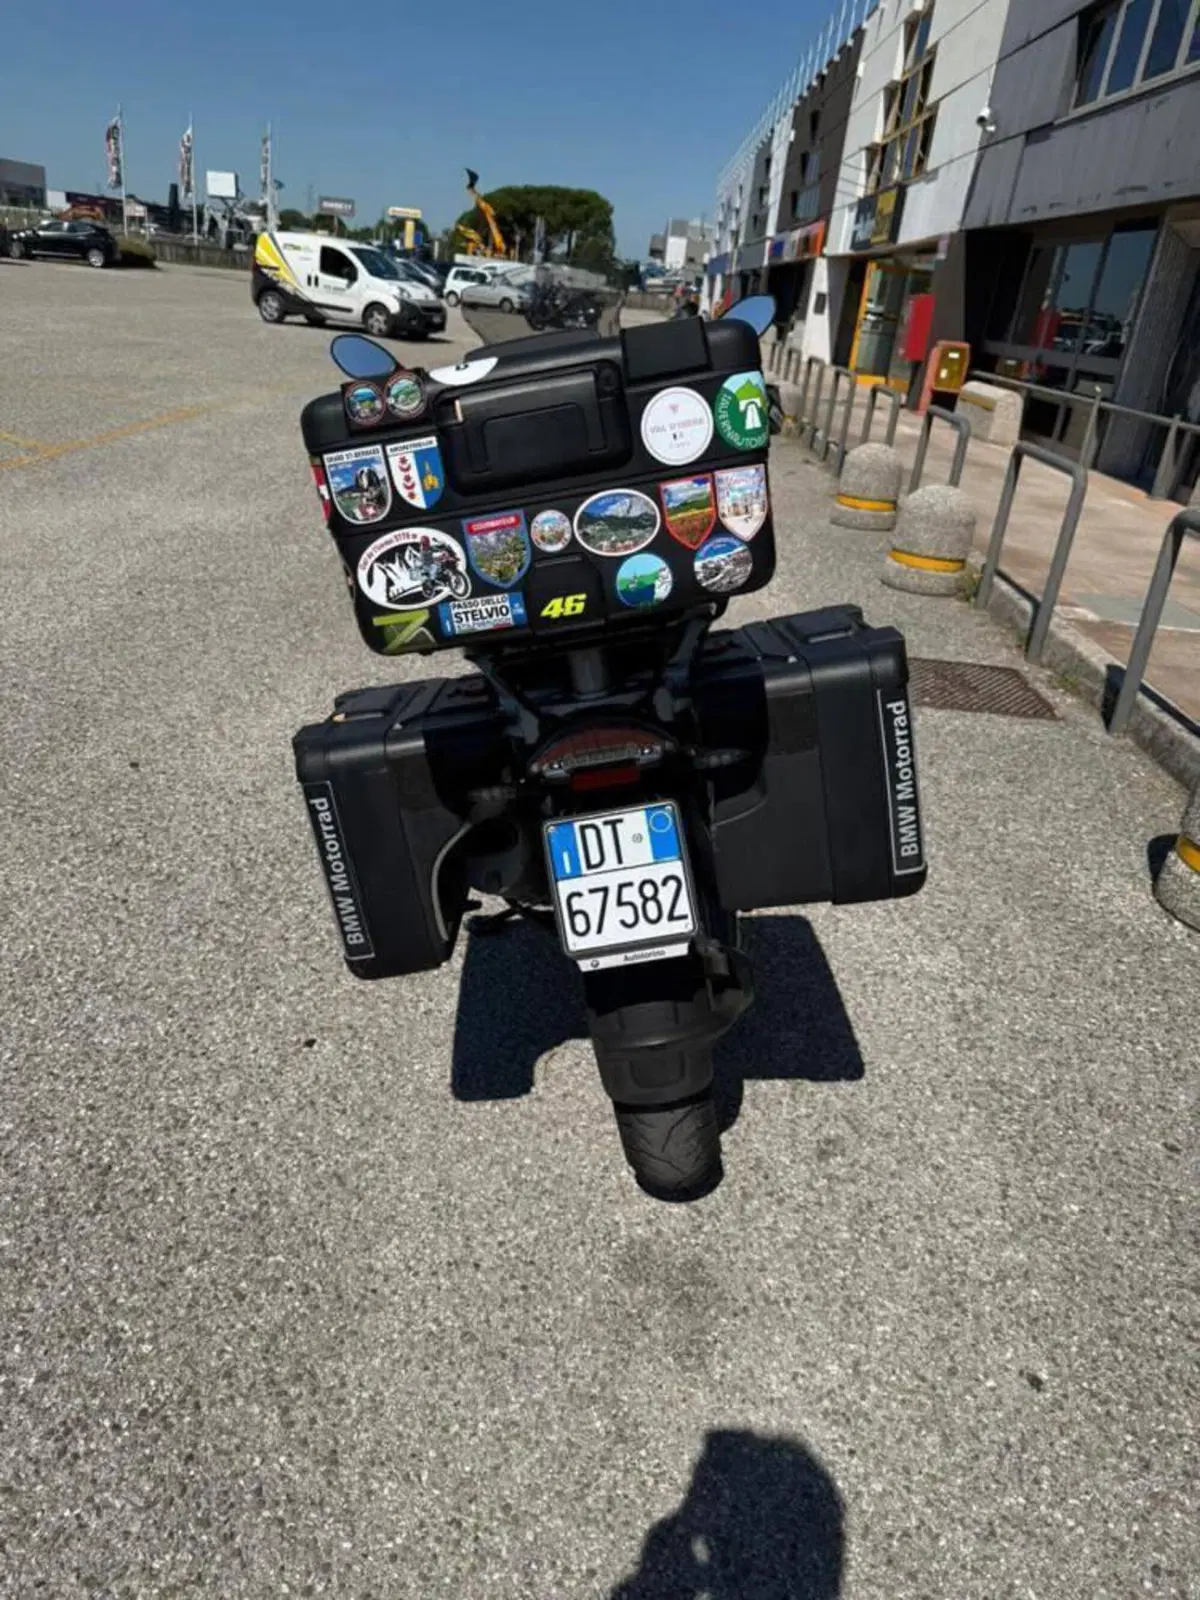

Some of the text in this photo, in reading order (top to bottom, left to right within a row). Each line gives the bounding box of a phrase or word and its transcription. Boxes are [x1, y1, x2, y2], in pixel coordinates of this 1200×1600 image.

[451, 593, 508, 611] PASSO DELLO
[453, 604, 510, 624] STELVIO
[541, 593, 588, 619] 46
[886, 699, 919, 857] BMW Motorrad
[309, 796, 365, 946] BMW Motorrad
[578, 818, 624, 871] DT
[566, 874, 689, 937] 67582
